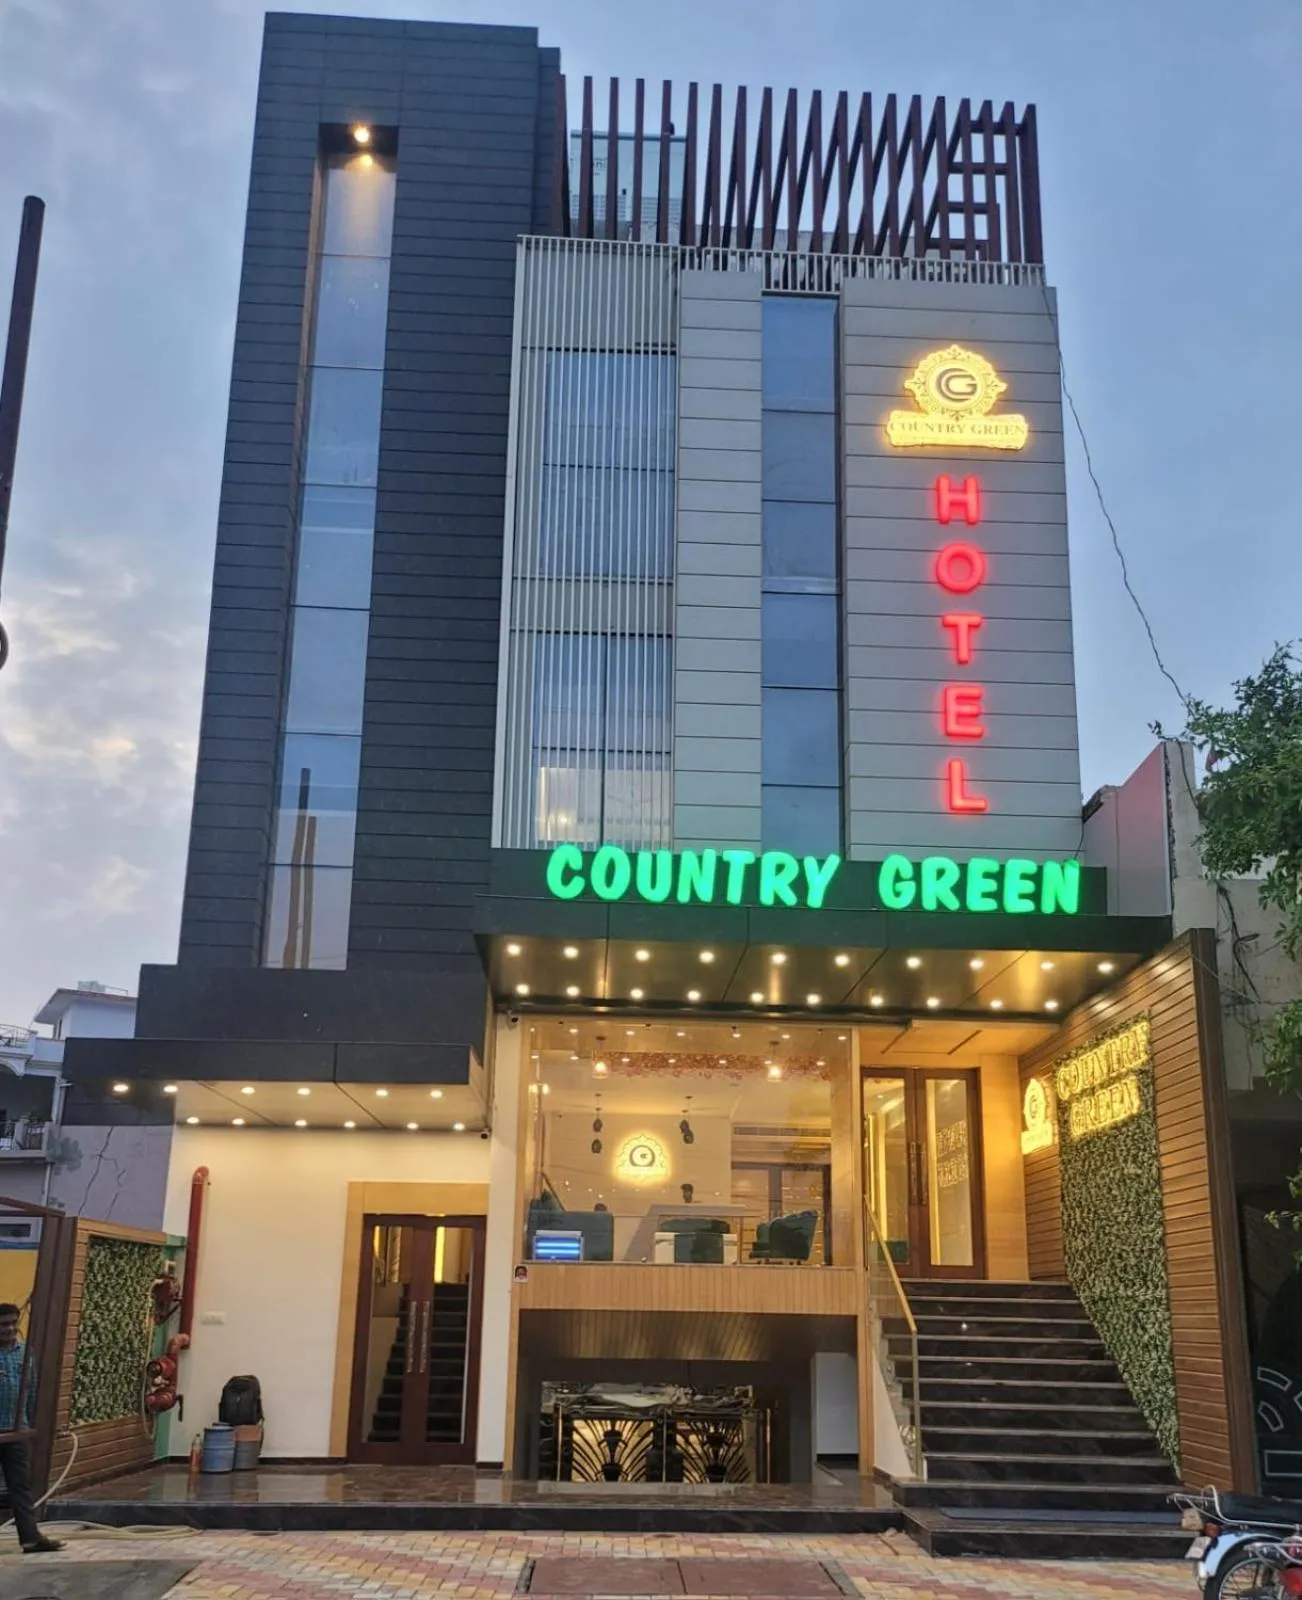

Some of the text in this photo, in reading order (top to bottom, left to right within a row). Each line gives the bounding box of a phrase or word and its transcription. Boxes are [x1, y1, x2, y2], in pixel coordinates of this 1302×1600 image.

[971, 424, 1025, 436] GREEN
[936, 475, 986, 813] HOTEL
[546, 844, 1080, 914] COUNTRY GREEN
[1070, 1076, 1140, 1137] GREEN
